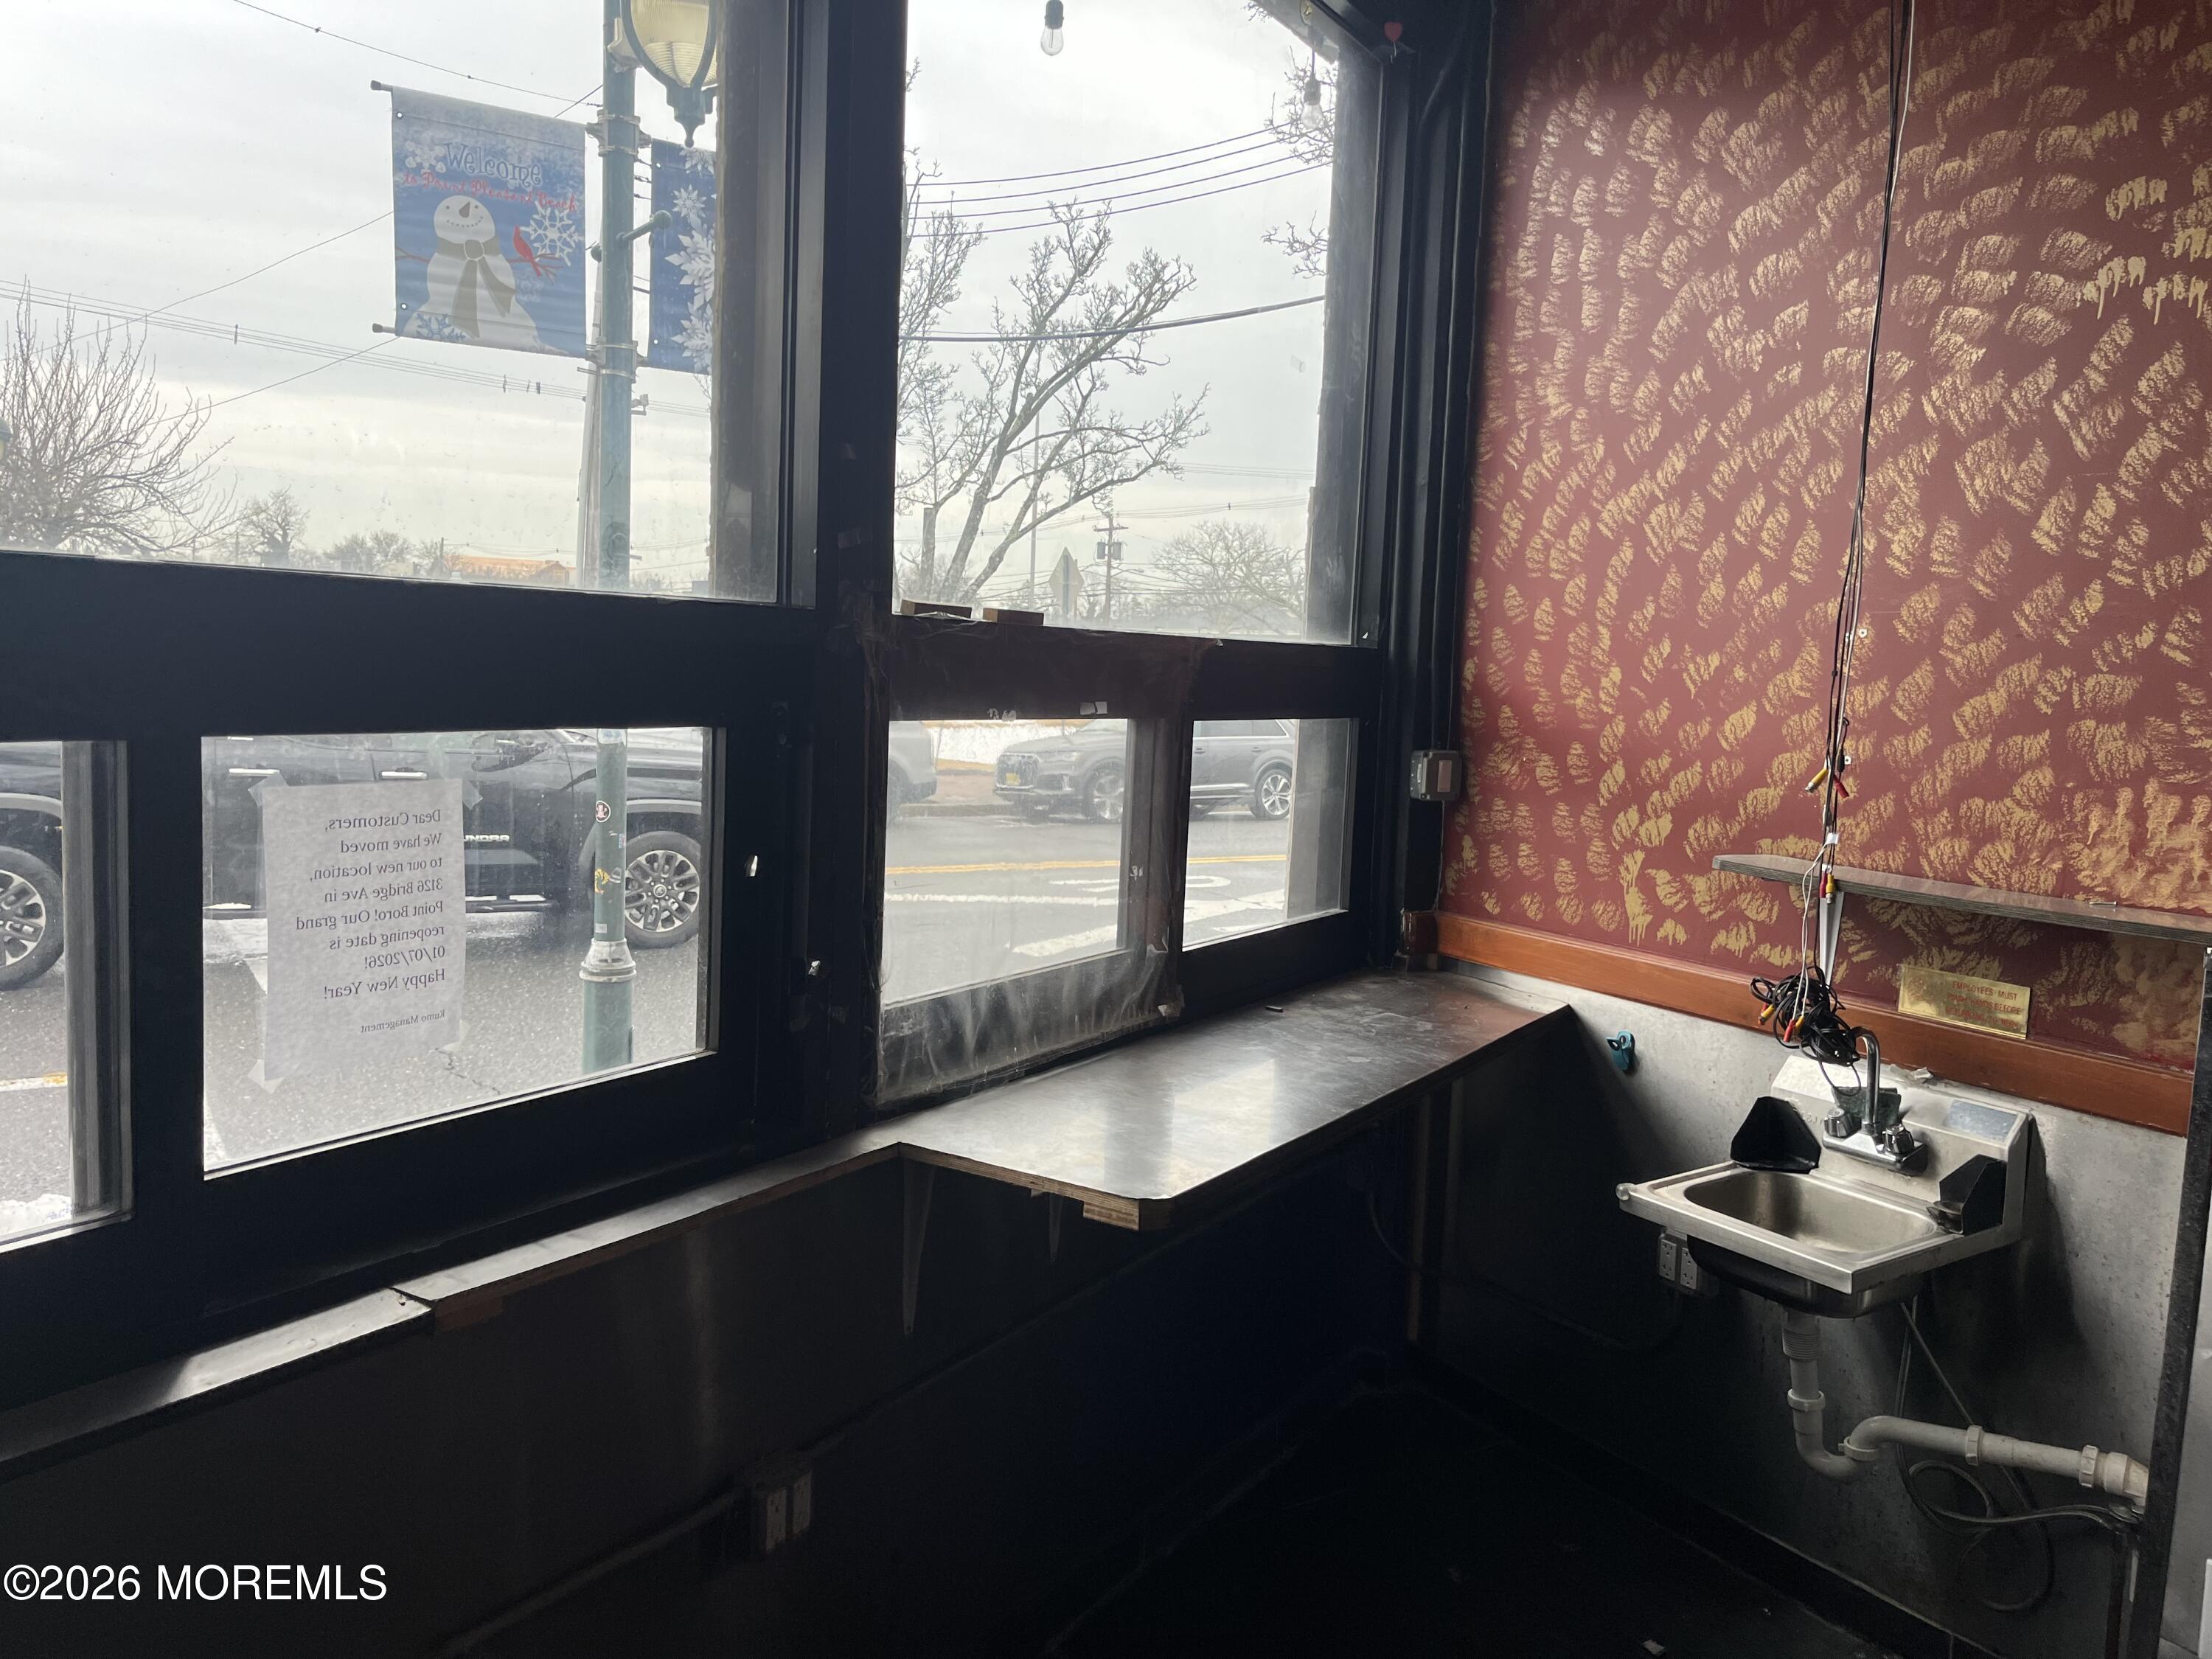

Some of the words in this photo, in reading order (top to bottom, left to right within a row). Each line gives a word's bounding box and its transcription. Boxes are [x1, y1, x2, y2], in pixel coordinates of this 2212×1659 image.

[443, 142, 542, 189] Welcome
[403, 172, 417, 185] to
[422, 172, 465, 192] Point
[470, 179, 532, 203] Pleasant
[538, 192, 577, 212] Beach
[1952, 981, 1994, 996] EMPLOYEES
[1998, 990, 2018, 1001] MUST
[1994, 1003, 2022, 1015] BEFORE
